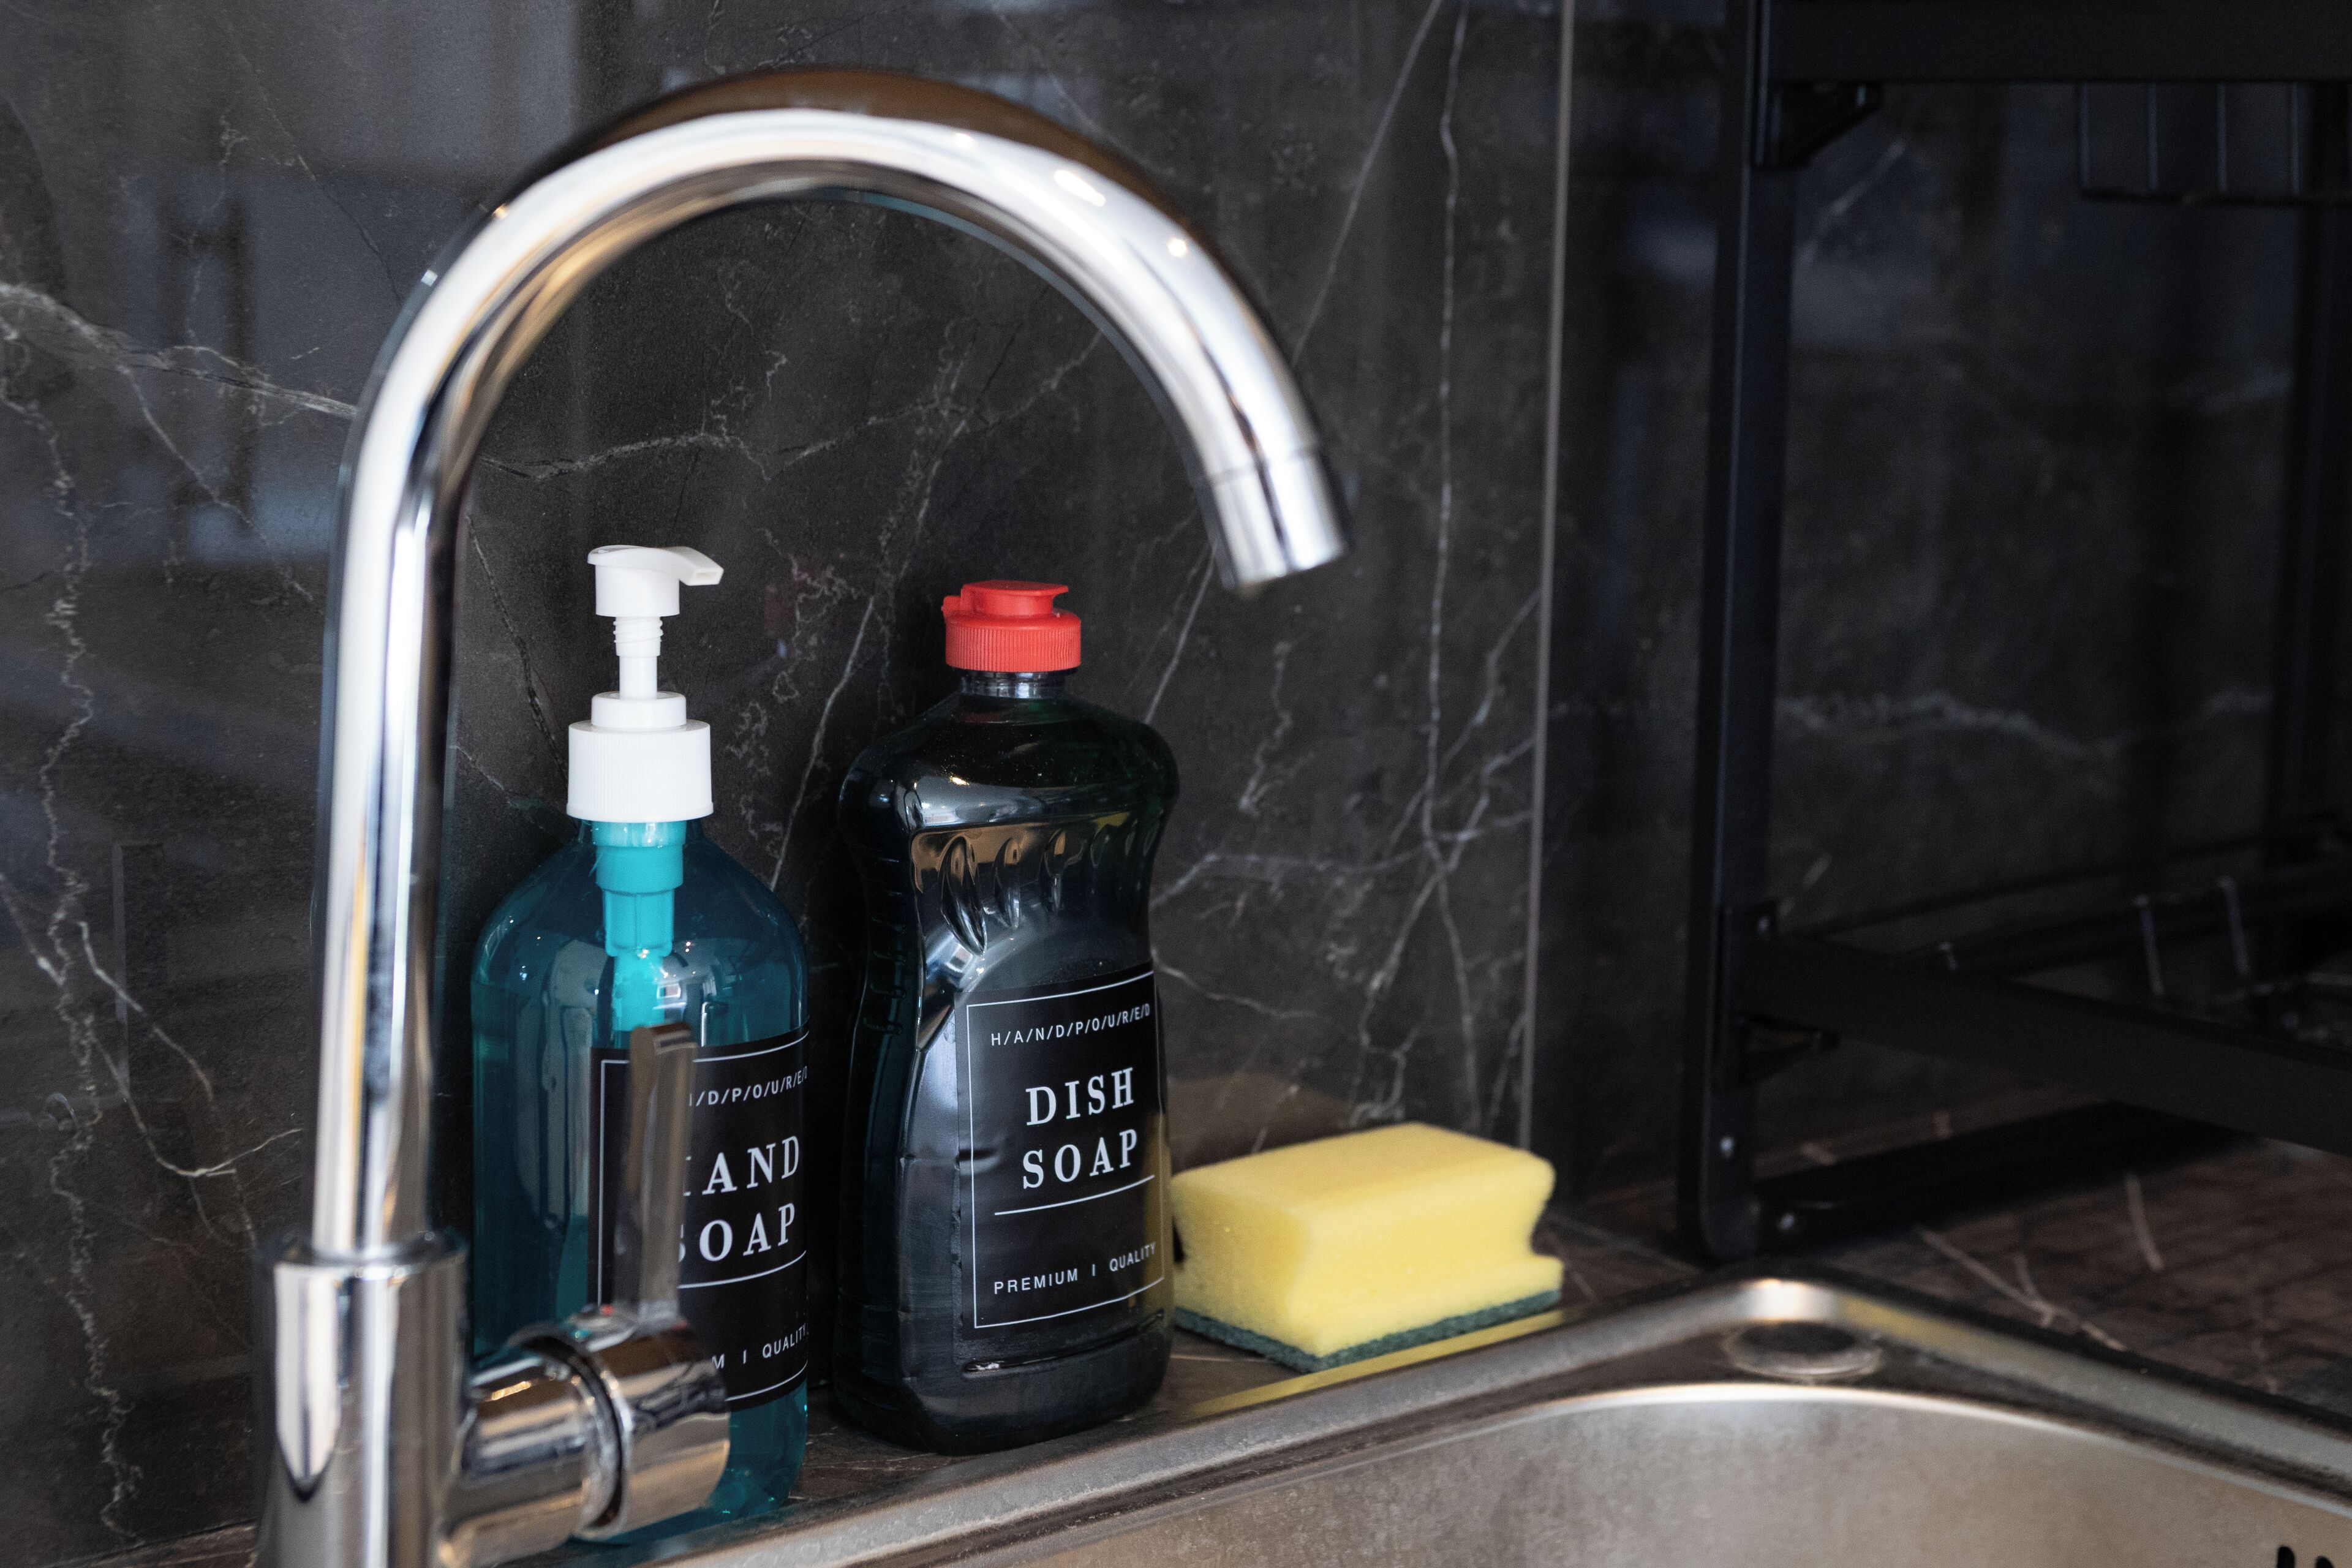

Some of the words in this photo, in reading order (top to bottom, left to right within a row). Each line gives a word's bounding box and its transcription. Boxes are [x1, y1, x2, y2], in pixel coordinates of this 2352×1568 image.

[991, 1003, 1150, 1046] H/A/N/D/P/O/U/R/E/D
[1025, 1067, 1134, 1126] DISH
[683, 1136, 799, 1196] AND
[1023, 1129, 1137, 1189] SOAP
[994, 1268, 1078, 1294] PREMIUM
[1109, 1242, 1156, 1272] QUALITY
